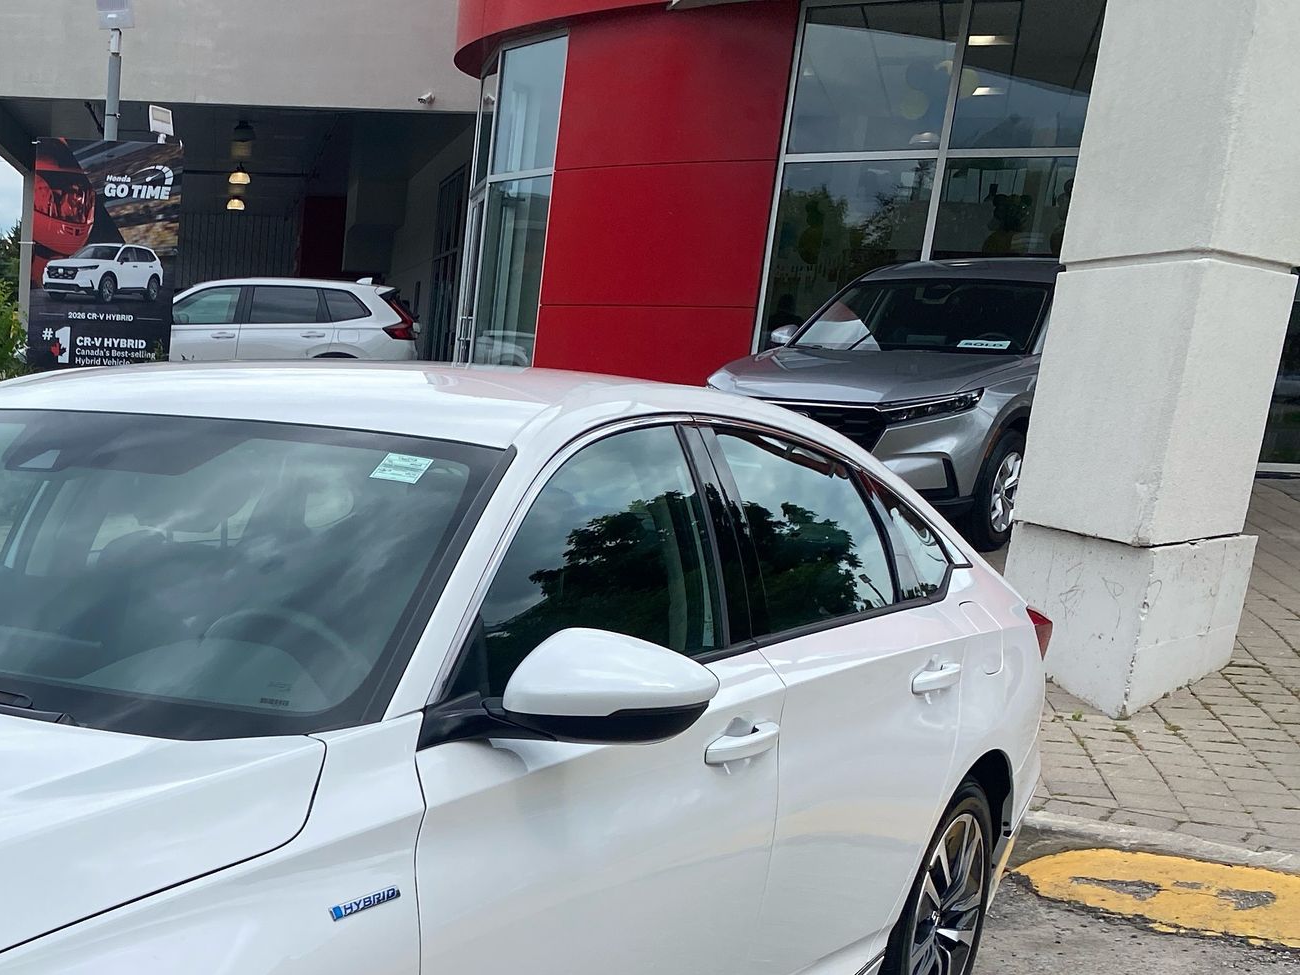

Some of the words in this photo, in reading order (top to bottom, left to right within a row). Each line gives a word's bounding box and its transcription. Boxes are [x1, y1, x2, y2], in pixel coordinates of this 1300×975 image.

[106, 174, 132, 183] Honda
[104, 184, 129, 198] GO
[131, 184, 172, 200] TIME
[68, 312, 86, 320] 2026
[87, 312, 105, 320] CR-V
[106, 314, 134, 322] HYBRID
[76, 336, 101, 348] CR-V
[104, 338, 147, 349] HYBRID
[75, 348, 110, 357] Canada's
[111, 349, 156, 360] Best-selling
[75, 357, 101, 366] Hybrid
[343, 887, 397, 916] HYBRID
